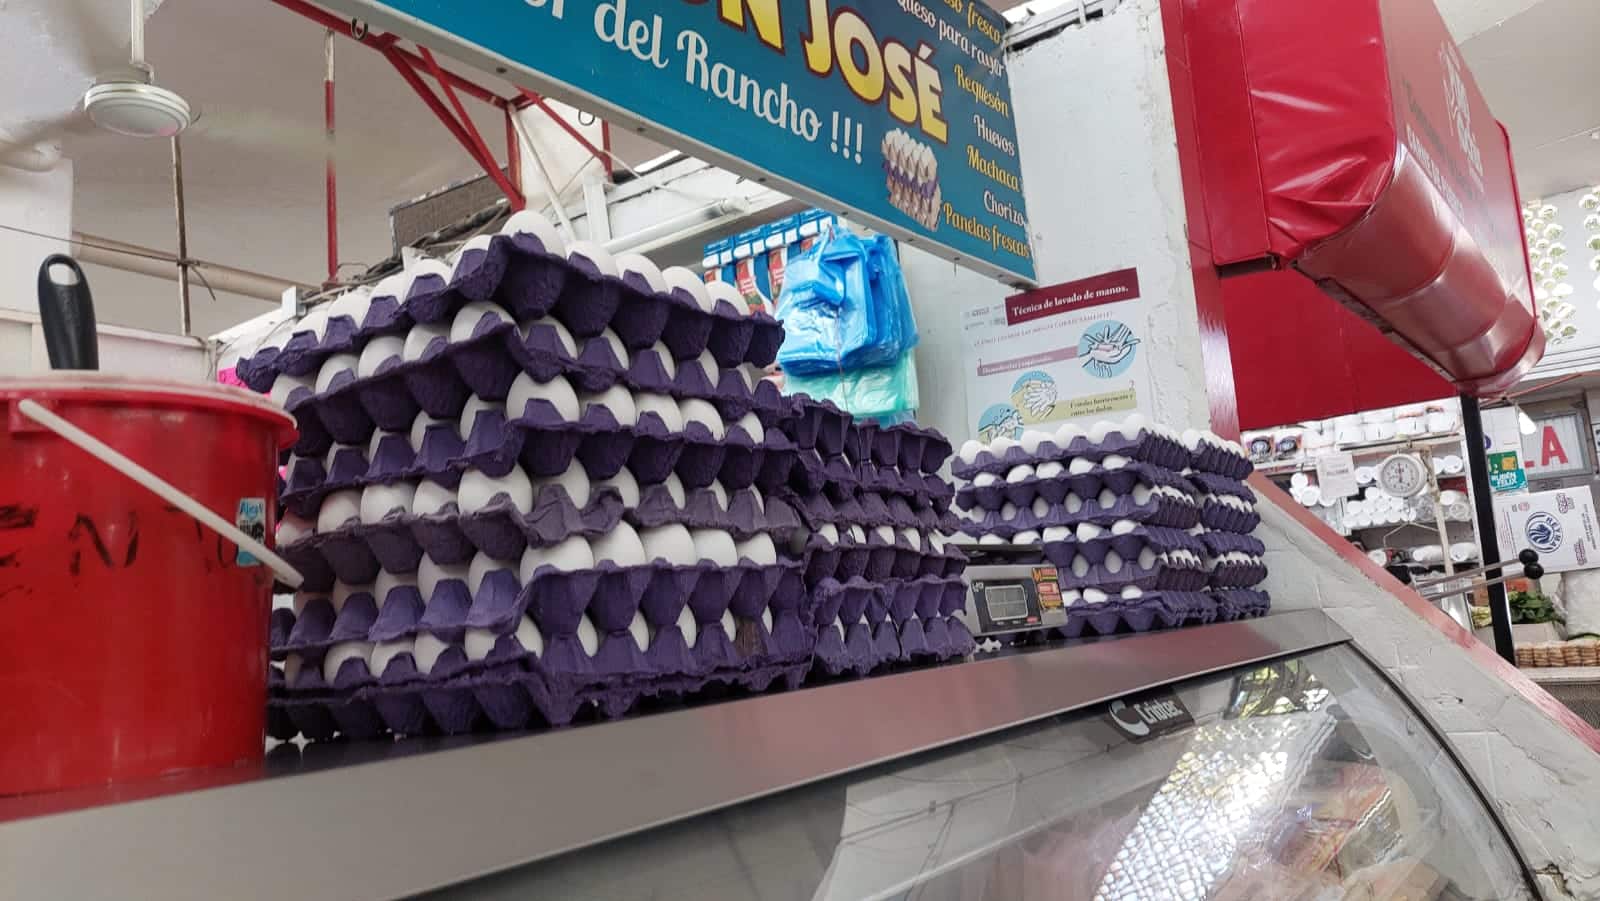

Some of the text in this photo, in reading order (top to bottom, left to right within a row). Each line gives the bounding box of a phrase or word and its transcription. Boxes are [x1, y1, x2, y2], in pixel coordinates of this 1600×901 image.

[939, 19, 970, 56] para
[971, 43, 1005, 77] rayar
[967, 2, 1001, 44] fresco
[594, 0, 863, 164] del Rancho !!!
[804, 0, 947, 143] JOSÉ
[954, 63, 1009, 118] Requesón
[973, 114, 1016, 156] Huevos
[967, 144, 1021, 192] Machaca
[943, 202, 1030, 258] Panelas frescas
[983, 190, 1025, 226] Chorizo
[1012, 303, 1042, 317] Técnica
[1043, 298, 1053, 309] de
[1055, 293, 1082, 307] lavado
[1083, 289, 1095, 300] de
[1096, 285, 1129, 298] manos.
